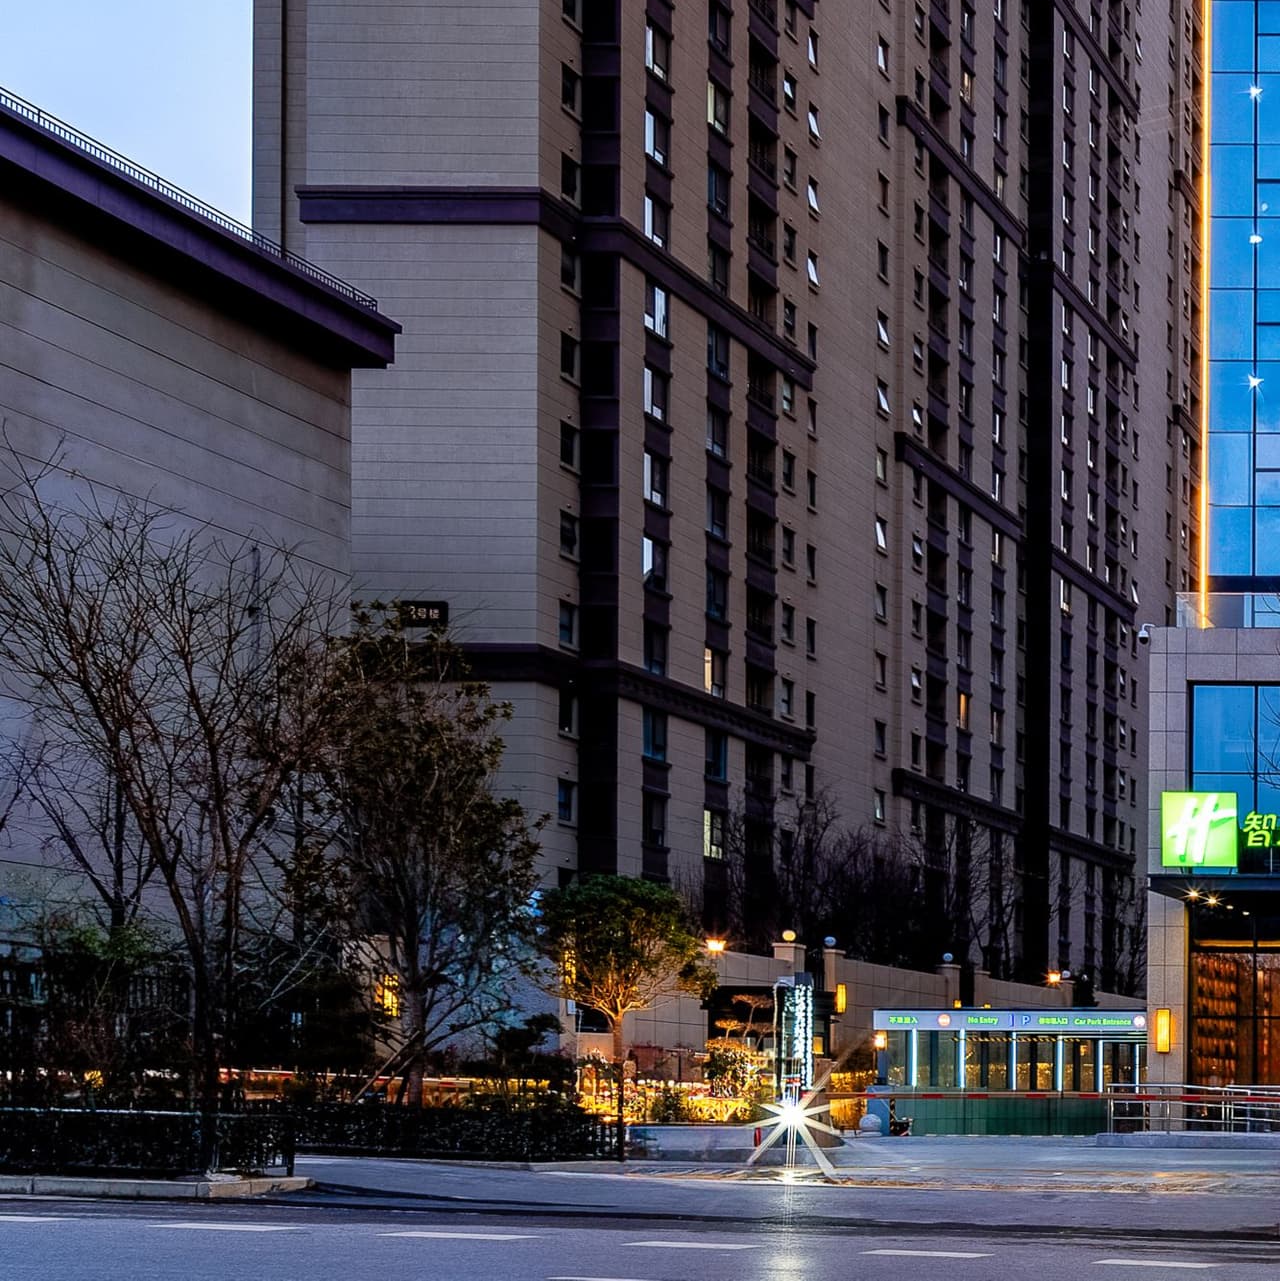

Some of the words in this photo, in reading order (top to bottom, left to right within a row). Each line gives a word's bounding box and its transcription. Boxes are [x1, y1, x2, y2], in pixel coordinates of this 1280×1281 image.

[967, 1016, 979, 1025] No
[979, 1016, 999, 1026] Entry
[1022, 1015, 1031, 1026] P
[1074, 1018, 1086, 1026] Car
[1087, 1018, 1101, 1026] Park
[1102, 1018, 1132, 1026] Entrance
